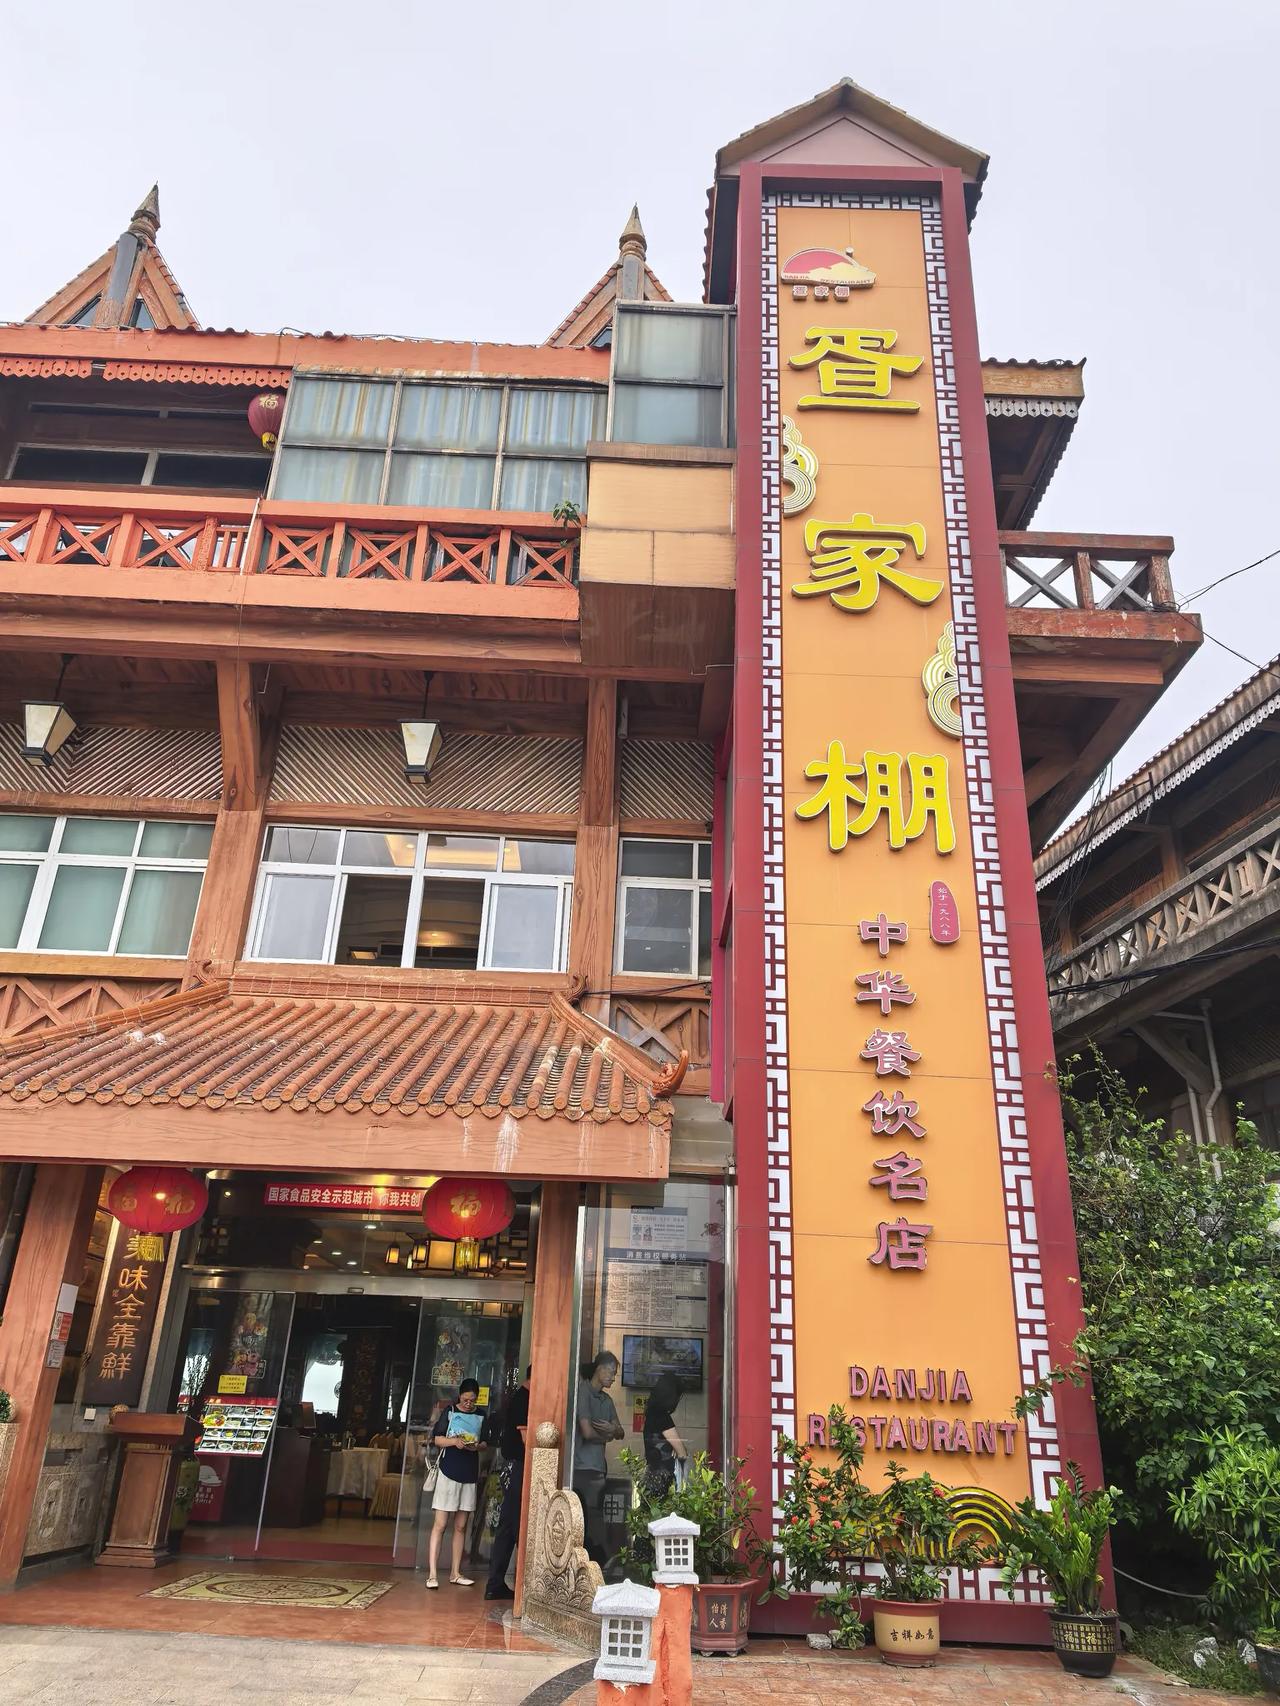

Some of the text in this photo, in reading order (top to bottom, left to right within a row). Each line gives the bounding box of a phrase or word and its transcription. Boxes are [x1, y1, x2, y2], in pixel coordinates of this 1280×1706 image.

[854, 911, 934, 1271] 中华餐饮名店
[267, 1186, 421, 1208] 国家食品安全示范城市 你我共创
[849, 1365, 973, 1402] DANJIA
[807, 1413, 1018, 1456] RSTAURANT
[889, 1627, 935, 1643] 吉祥如意
